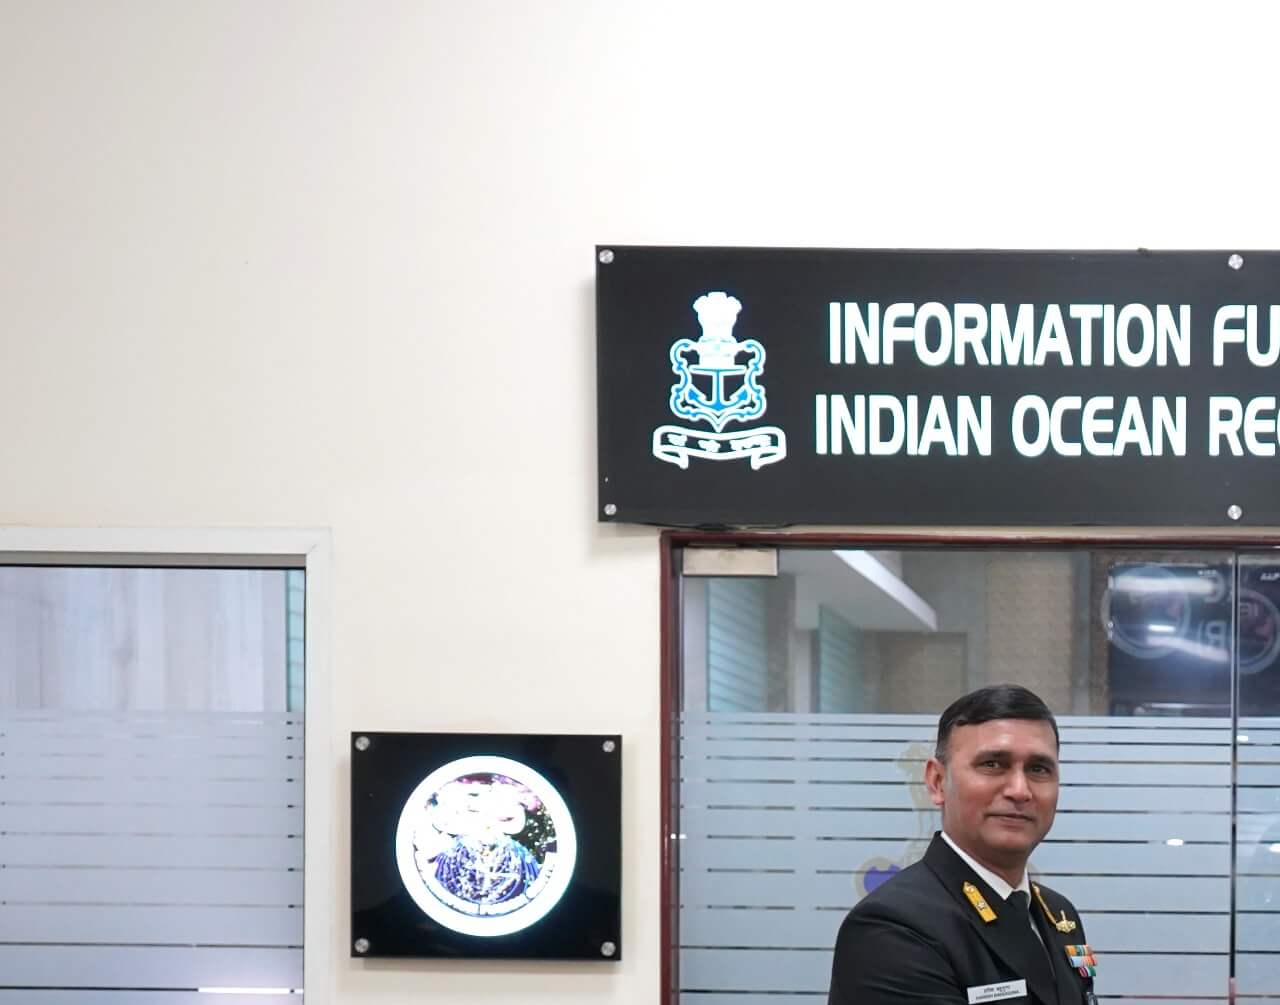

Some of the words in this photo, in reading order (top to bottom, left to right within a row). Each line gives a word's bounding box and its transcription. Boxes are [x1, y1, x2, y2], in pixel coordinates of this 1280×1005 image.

[829, 301, 1191, 368] INFORMATION
[815, 394, 992, 457] INDIAN
[1011, 394, 1187, 458] OCEAN
